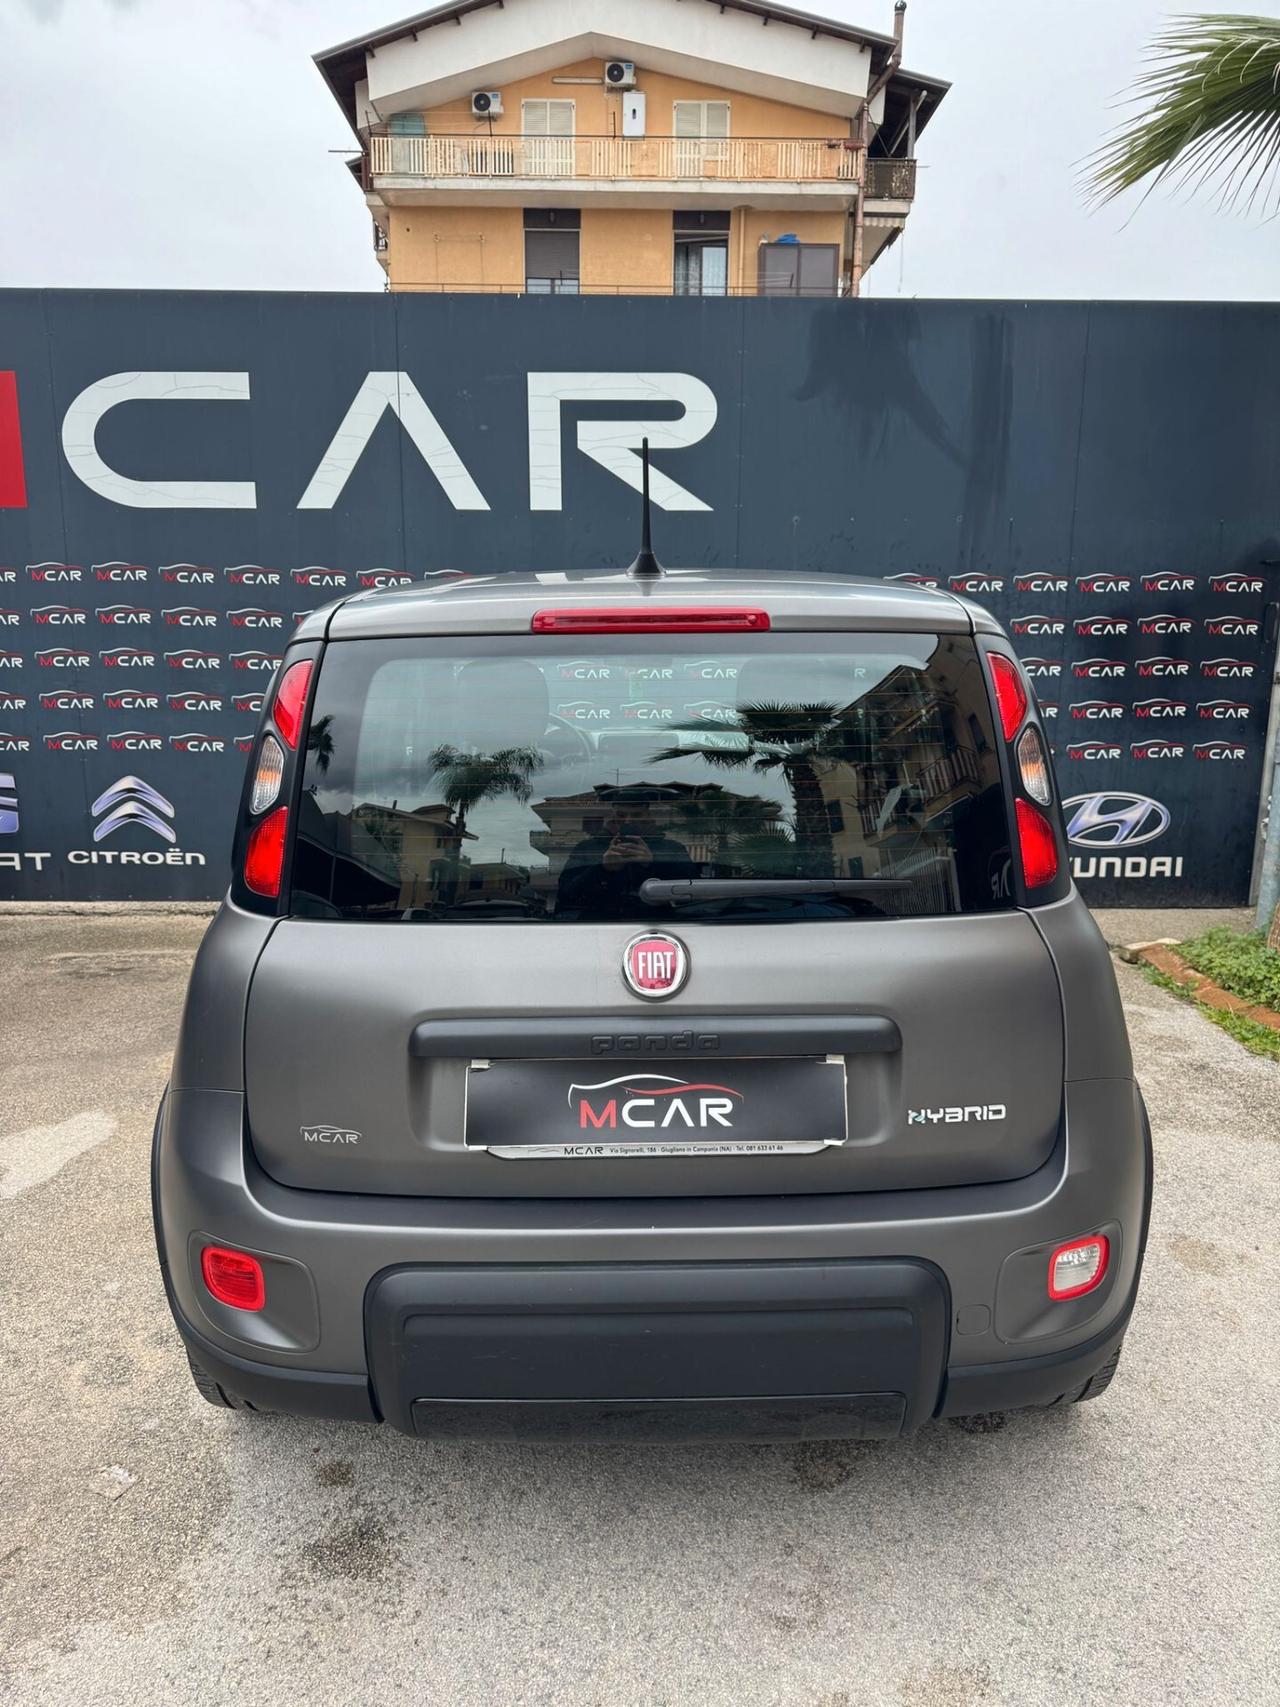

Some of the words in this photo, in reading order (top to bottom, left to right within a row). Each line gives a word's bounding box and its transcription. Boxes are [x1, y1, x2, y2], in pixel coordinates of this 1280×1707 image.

[31, 570, 82, 582] MCAR
[96, 570, 148, 582] MCAR
[164, 572, 215, 583] MCAR
[230, 573, 280, 585] MCAR
[295, 574, 347, 587] MCAR
[952, 581, 1004, 592] MCAR
[1017, 581, 1068, 592] MCAR
[1080, 581, 1131, 593] MCAR
[1145, 579, 1195, 591] MCAR
[1213, 581, 1263, 593] MCAR
[35, 613, 86, 625] MCAR
[100, 613, 151, 624] MCAR
[166, 615, 217, 627] MCAR
[232, 616, 283, 628] MCAR
[1014, 623, 1065, 635] MCAR
[1078, 624, 1128, 635] MCAR
[1142, 622, 1192, 634] MCAR
[1208, 624, 1258, 636] MCAR
[39, 656, 90, 667] MCAR
[104, 655, 155, 667] MCAR
[168, 657, 220, 669] MCAR
[1025, 665, 1062, 677] CAR
[1075, 666, 1126, 678] MCAR
[1139, 664, 1189, 676] MCAR
[1204, 665, 1254, 678] MCAR
[43, 698, 94, 709] MCAR
[108, 697, 159, 709] MCAR
[171, 699, 222, 711] MCAR
[1072, 707, 1123, 719] MCAR
[1136, 706, 1186, 717] MCAR
[1200, 707, 1250, 719] MCAR
[47, 739, 98, 750] MCAR
[111, 739, 162, 750] MCAR
[175, 741, 225, 752] MCAR
[1070, 748, 1122, 760] MCAR
[1133, 747, 1184, 759] MCAR
[1195, 748, 1246, 760] MCAR
[0, 853, 51, 871] AT
[1070, 857, 1183, 878] UNDAI
[638, 952, 674, 979] FIAT
[579, 1098, 734, 1129] MCAR
[908, 1104, 1006, 1125] HYBRID
[304, 1131, 358, 1144] MCAR
[564, 1146, 604, 1155] MCAR
